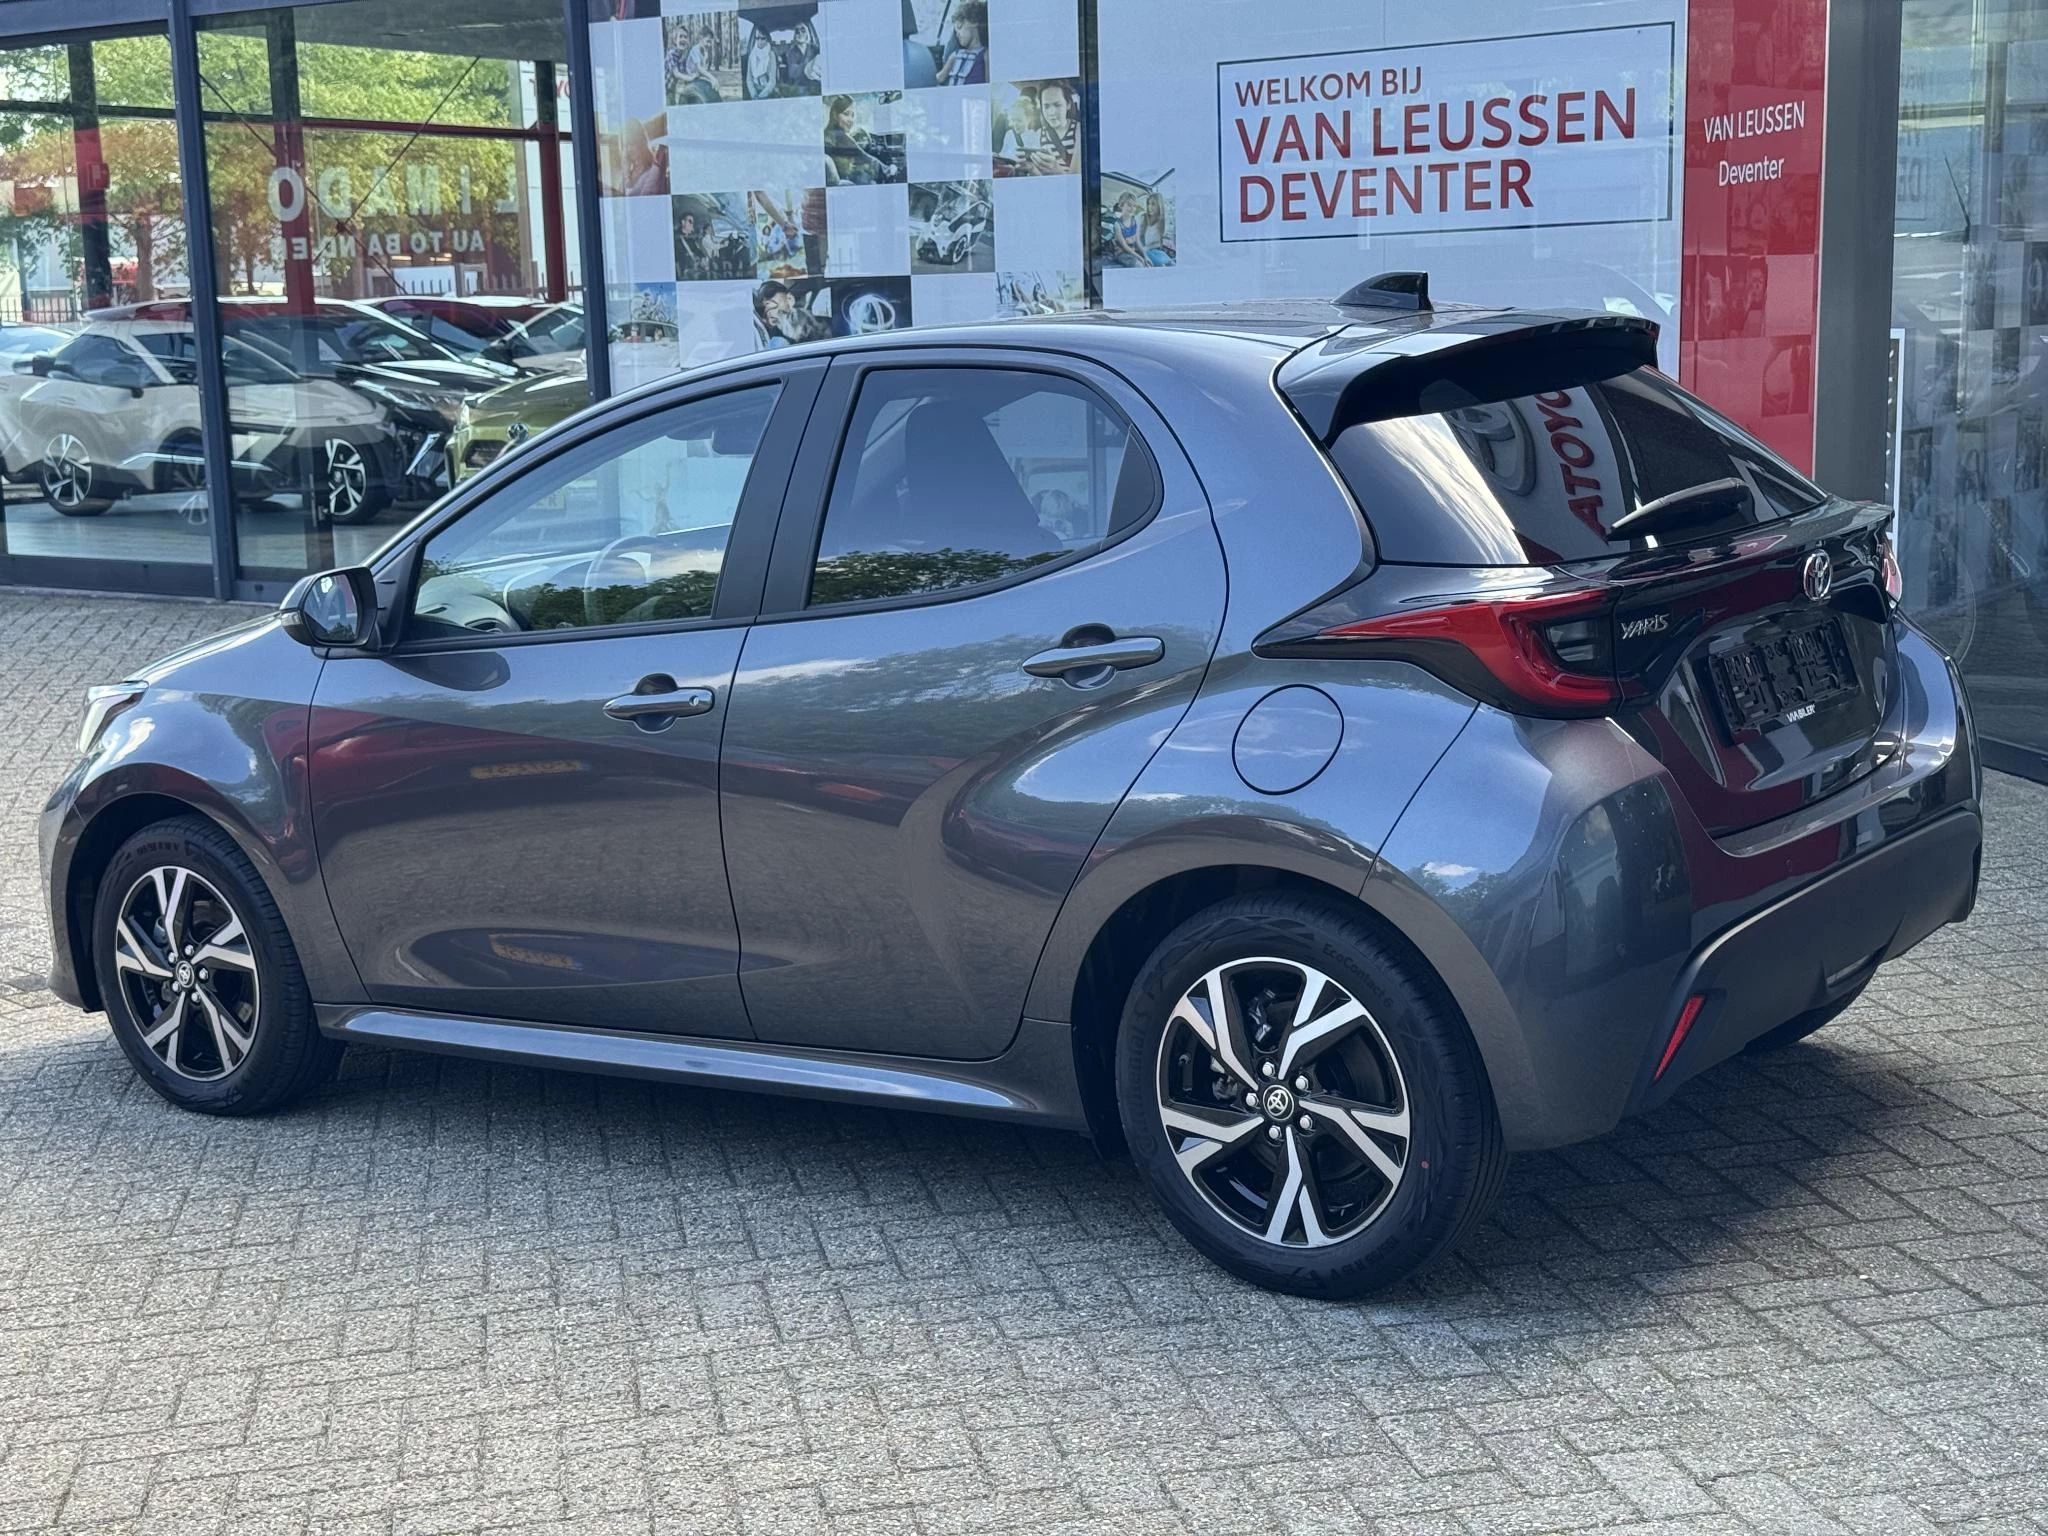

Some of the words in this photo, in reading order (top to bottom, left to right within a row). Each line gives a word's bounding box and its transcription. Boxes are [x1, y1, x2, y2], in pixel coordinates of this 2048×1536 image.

[1235, 70, 1371, 107] WELKOM
[1382, 66, 1422, 95] BIJ
[1235, 110, 1352, 165] VAN
[1373, 87, 1636, 157] LEUSSEN
[1703, 113, 1734, 144] VAN
[1738, 100, 1805, 138] LEUSSEN
[1239, 158, 1534, 223] DEVENTER
[1718, 155, 1785, 187] Deventer
[1620, 613, 1670, 640] YARIS
